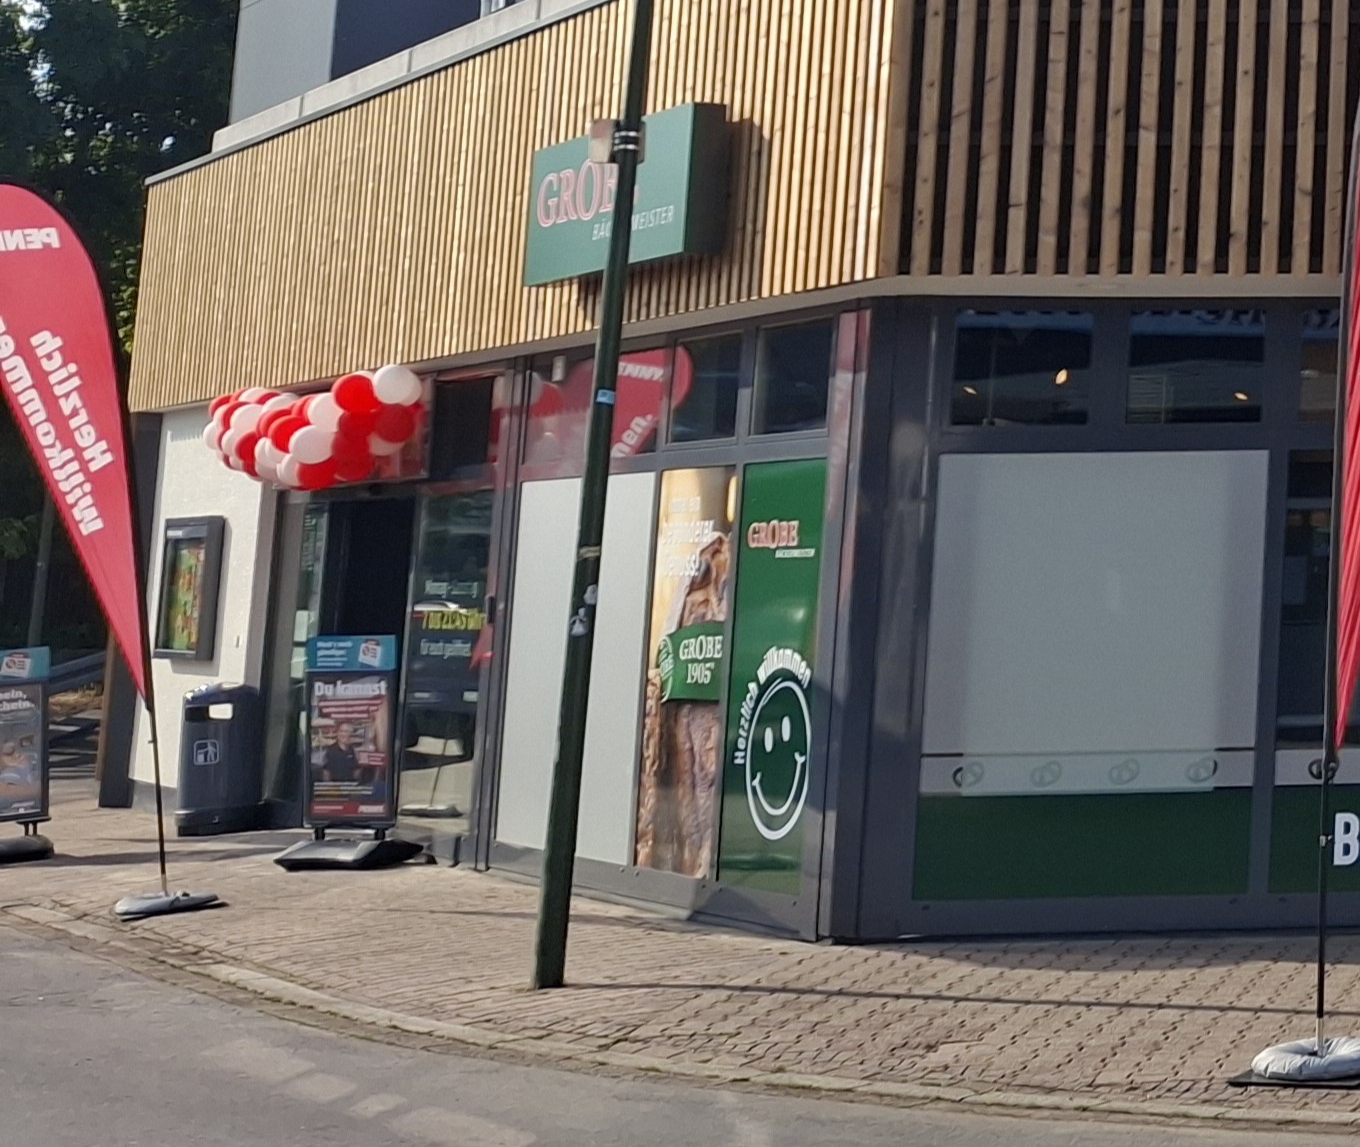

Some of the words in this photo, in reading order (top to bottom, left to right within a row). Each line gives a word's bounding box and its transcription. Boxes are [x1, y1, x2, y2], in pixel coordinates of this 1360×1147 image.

[537, 158, 639, 228] GROB
[747, 521, 799, 549] GROBE
[679, 635, 723, 660] GROBE
[734, 682, 759, 765] Herzlich
